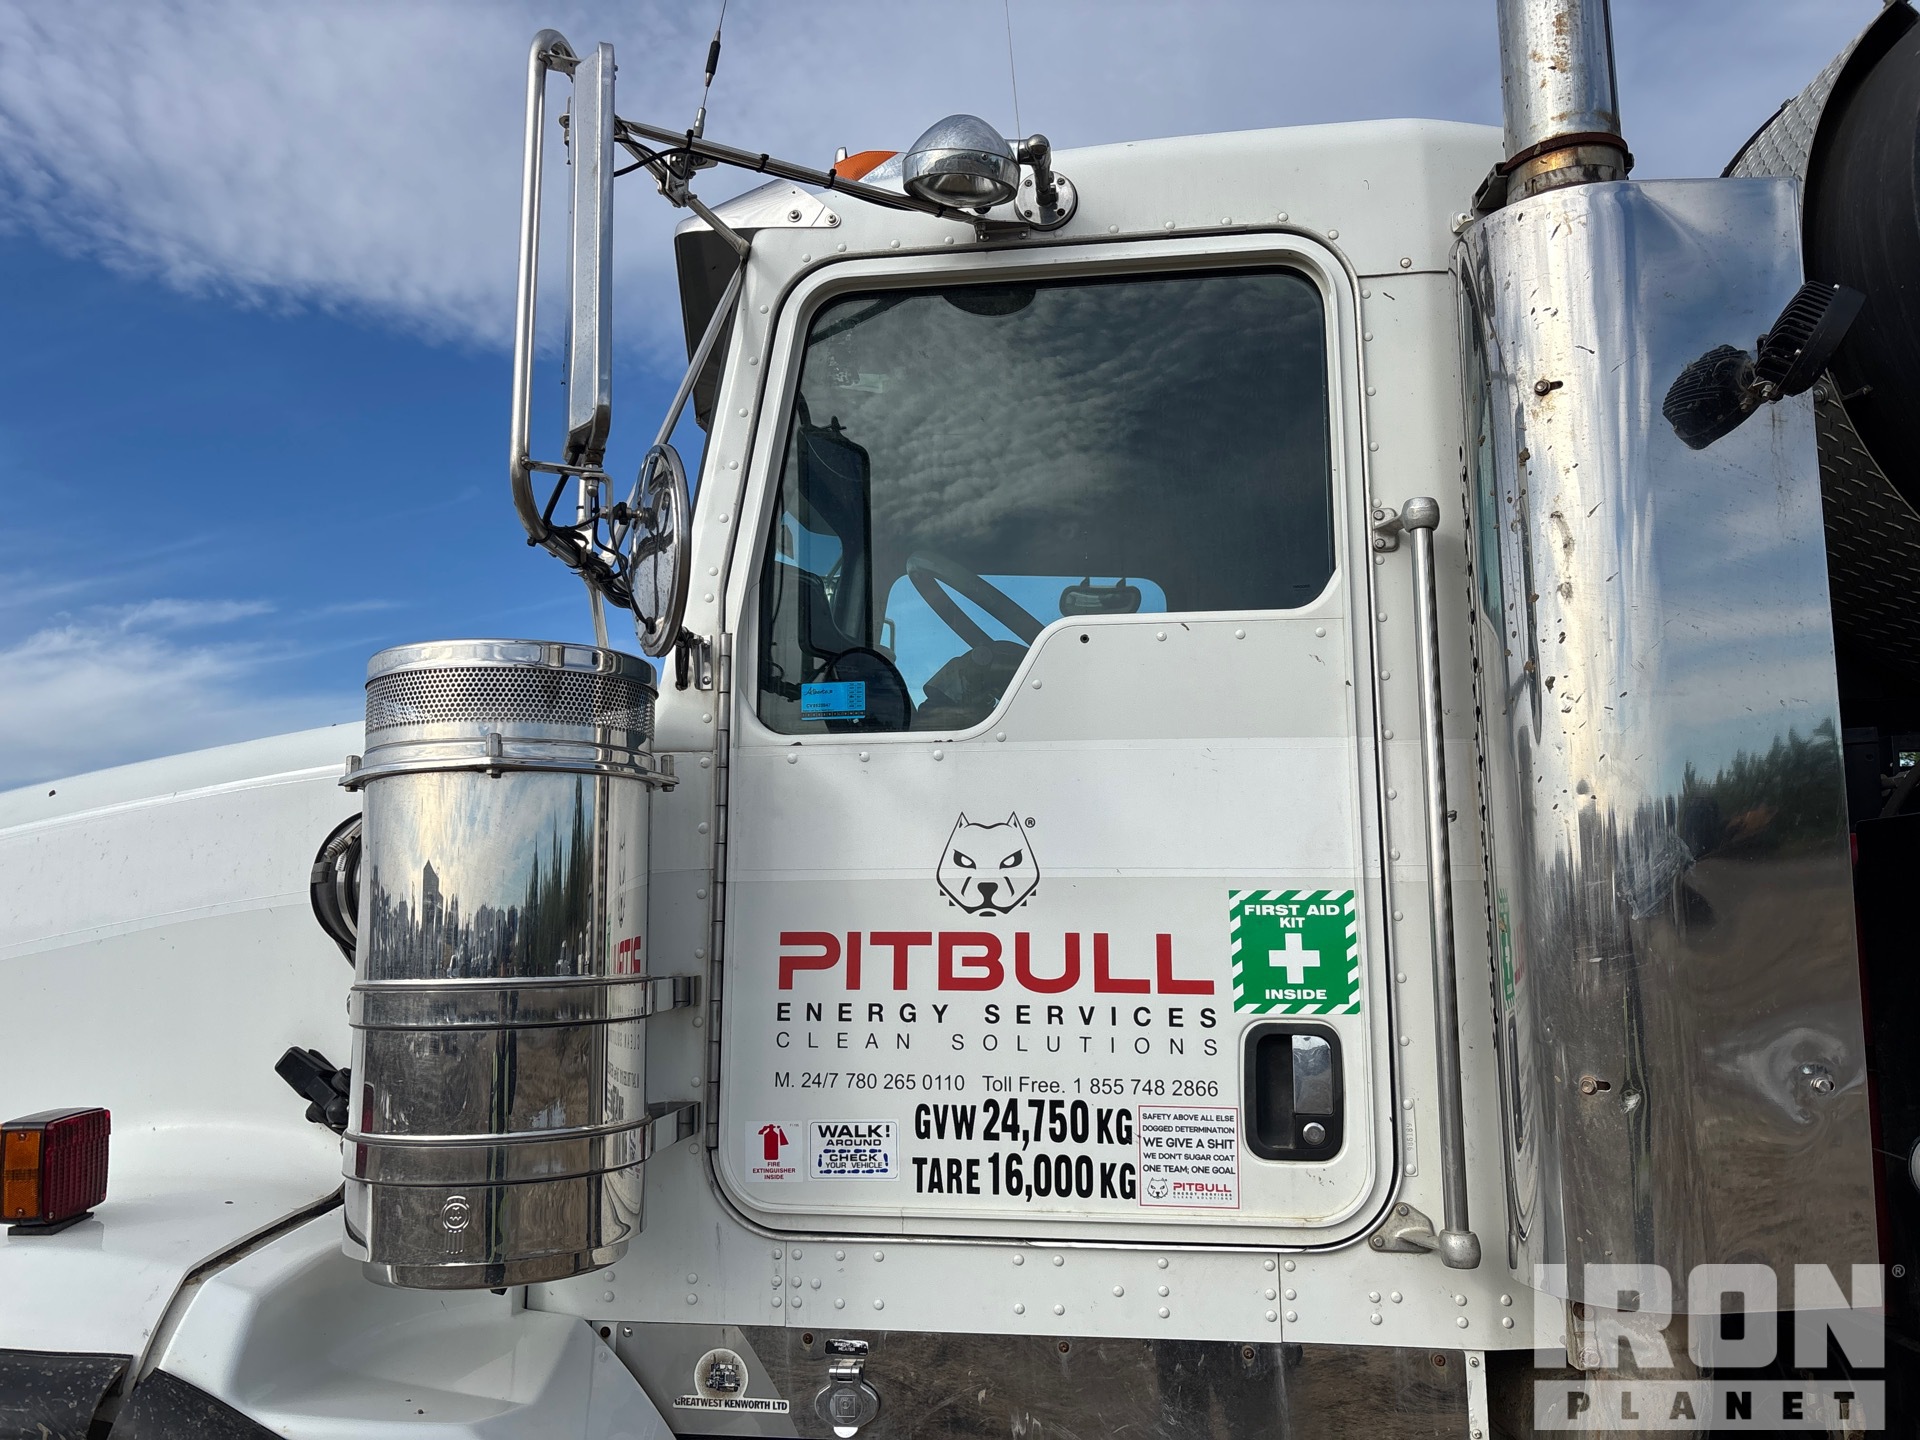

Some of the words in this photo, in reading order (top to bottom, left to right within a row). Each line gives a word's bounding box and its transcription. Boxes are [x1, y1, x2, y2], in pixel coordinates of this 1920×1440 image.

[1244, 904, 1300, 916] FIRST
[1306, 904, 1340, 916] AID
[1280, 917, 1305, 928] KIT
[778, 931, 1215, 995] PITBULL
[1265, 989, 1327, 1000] INSIDE
[776, 1002, 949, 1023] ENERGY
[984, 1004, 1217, 1028] SERVICES
[776, 1031, 910, 1049] CLEAN
[951, 1033, 1218, 1056] SOLUTIONS
[774, 1072, 795, 1088] M.
[801, 1072, 838, 1088] 24/7
[846, 1073, 877, 1089] 780
[884, 1074, 916, 1090] 265
[922, 1074, 965, 1091] 0110
[982, 1076, 1012, 1092] Toll
[1019, 1076, 1065, 1093] Free.
[1074, 1077, 1081, 1094] 1
[1090, 1078, 1124, 1095] 855
[1130, 1079, 1165, 1096] 748
[1172, 1080, 1219, 1097] 2866
[914, 1103, 976, 1140] GVW
[983, 1098, 1089, 1151] 24,750
[1096, 1108, 1133, 1145] KG
[1175, 1126, 1234, 1134] DETERMINATION
[1143, 1137, 1163, 1148] WE
[1166, 1138, 1192, 1148] GIVE
[1196, 1138, 1204, 1148] A
[1208, 1139, 1235, 1149] SHIT
[1142, 1164, 1161, 1172] ONE
[1163, 1165, 1190, 1174] TEAM;
[1191, 1166, 1210, 1174] ONE
[1212, 1166, 1236, 1174] GOAL
[912, 1157, 980, 1194] TARE
[988, 1152, 1094, 1202] 16,000
[1100, 1162, 1136, 1200] KG
[1173, 1182, 1232, 1192] PITBULL
[675, 1397, 722, 1407] GREATWEST
[725, 1400, 770, 1410] KENWORTH
[773, 1402, 788, 1410] LTD
